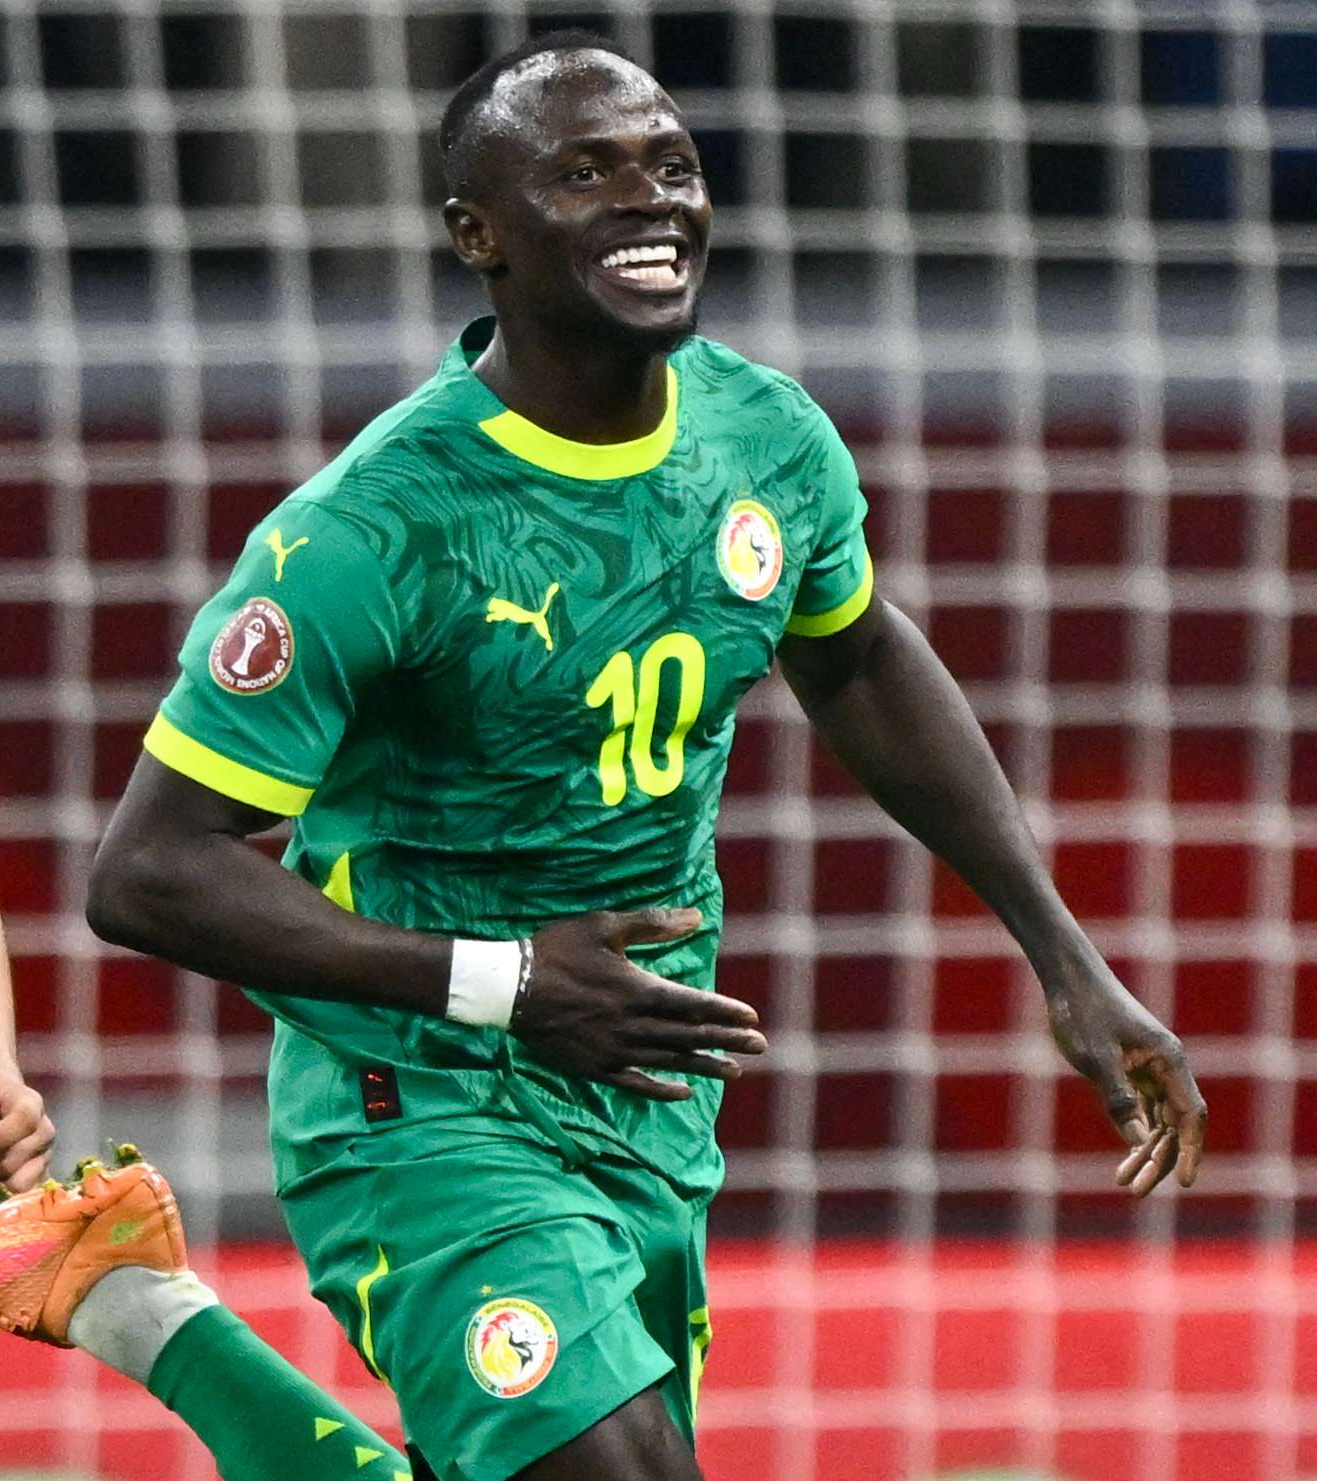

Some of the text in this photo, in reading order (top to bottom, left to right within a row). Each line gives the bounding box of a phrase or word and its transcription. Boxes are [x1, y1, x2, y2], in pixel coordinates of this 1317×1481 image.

[264, 607, 286, 637] AFRICA
[280, 638, 289, 659] CUP
[274, 659, 286, 674] OF
[236, 671, 277, 688] NATIONS
[586, 632, 705, 806] 10
